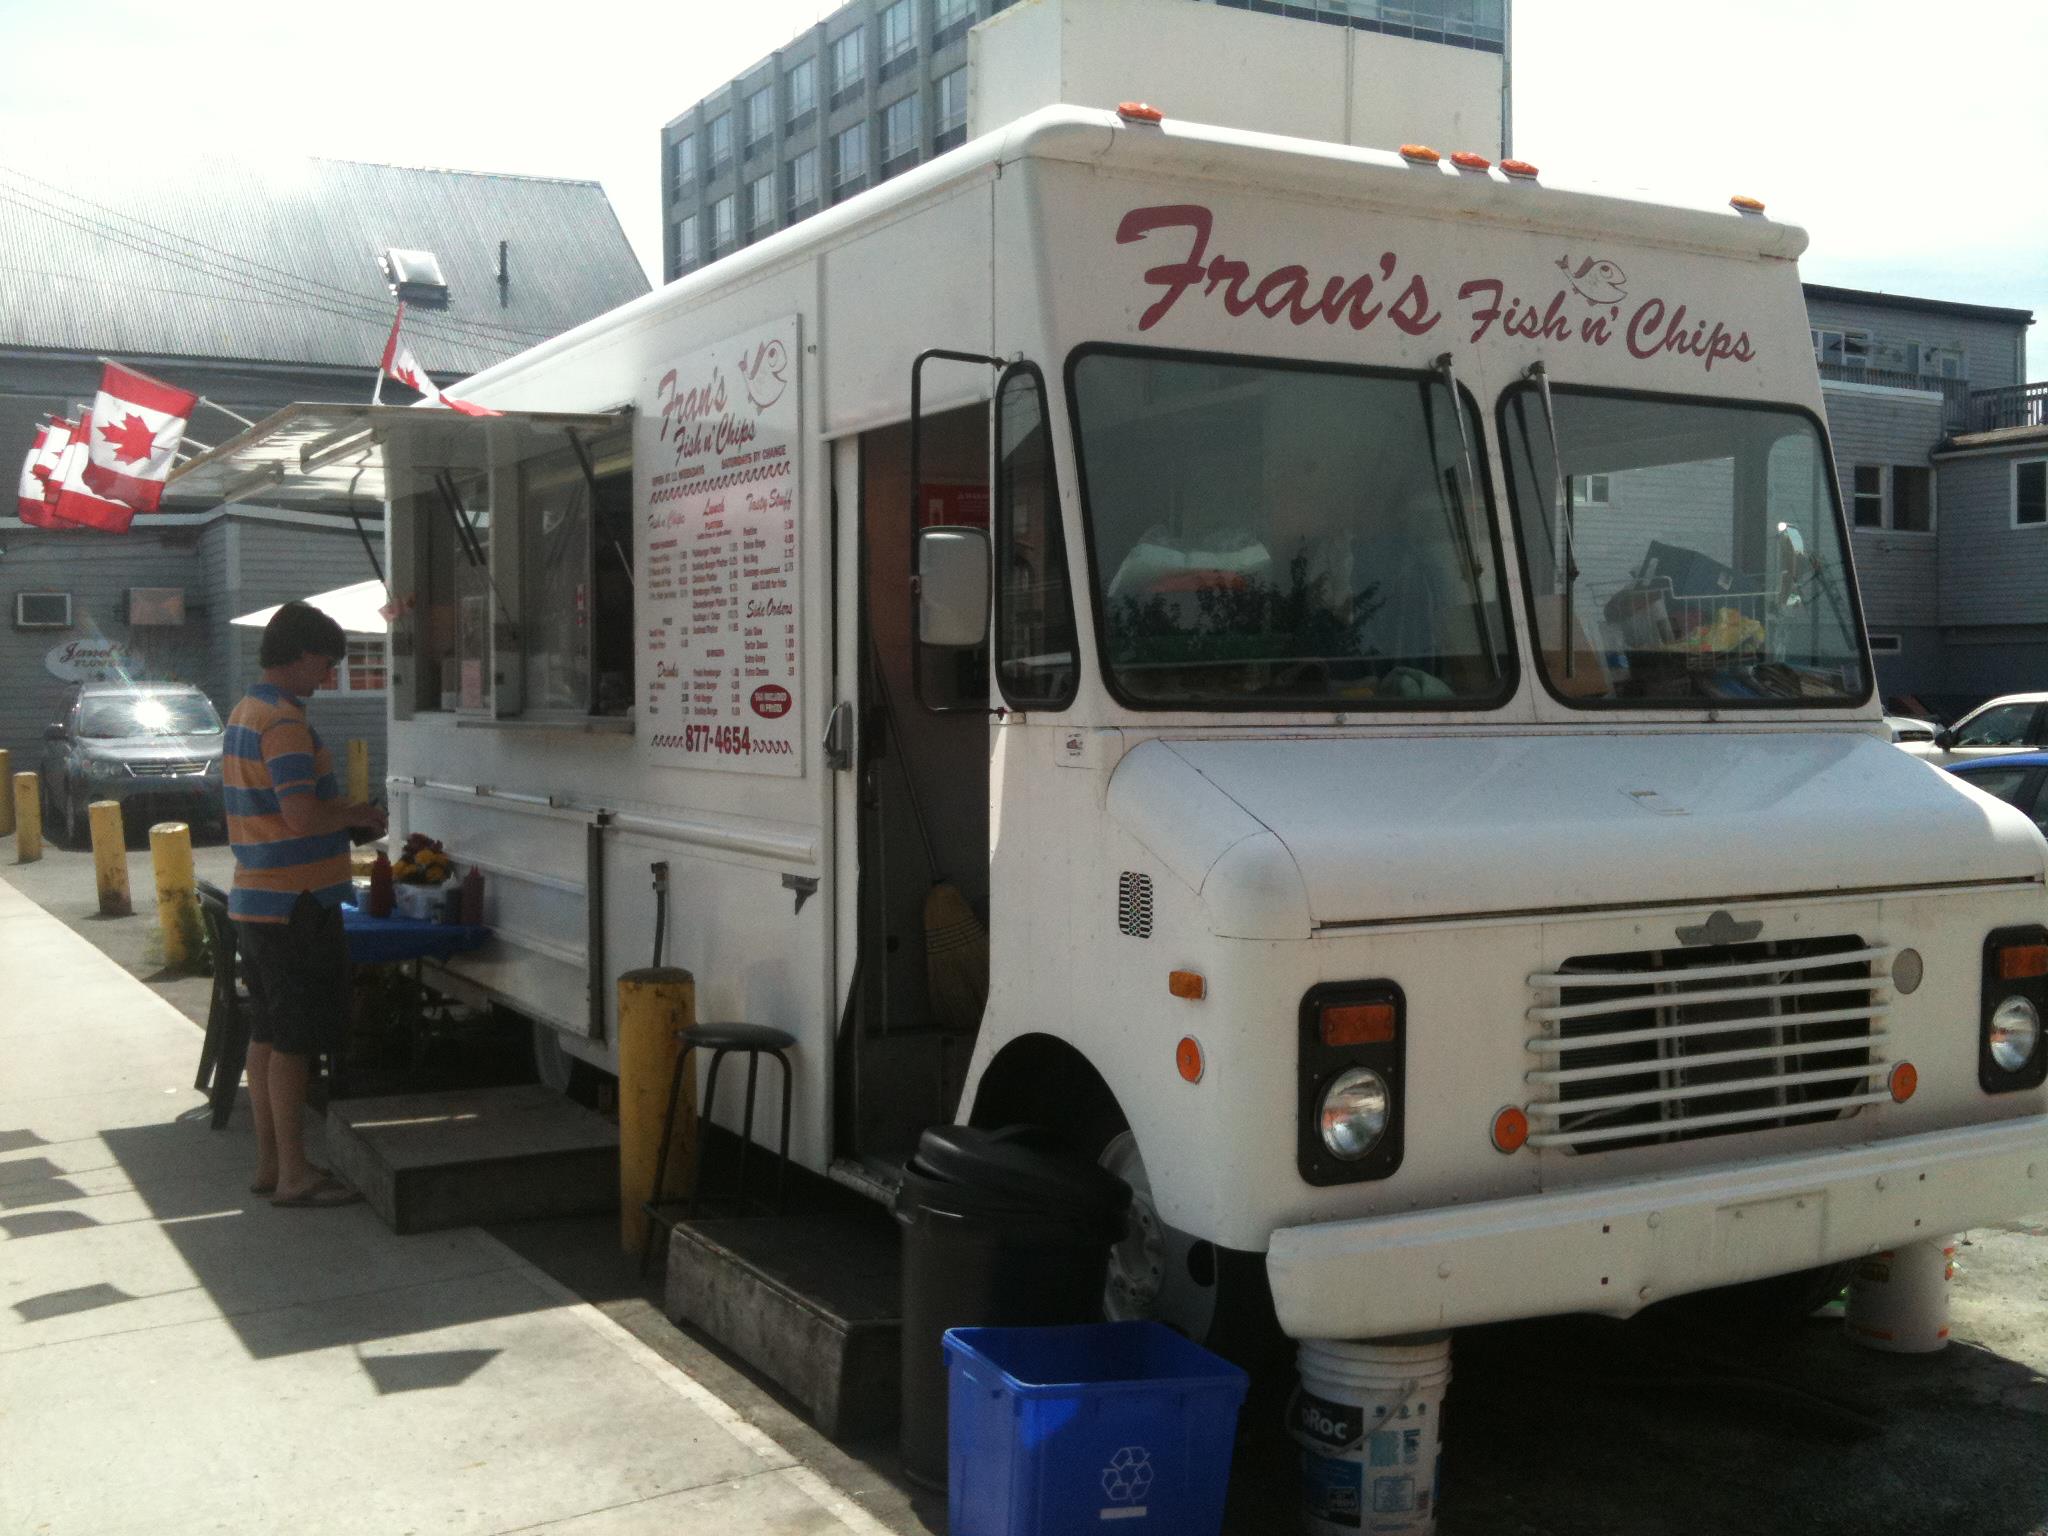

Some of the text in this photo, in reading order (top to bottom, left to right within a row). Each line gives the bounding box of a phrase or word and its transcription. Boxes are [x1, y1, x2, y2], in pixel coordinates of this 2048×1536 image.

[1116, 205, 1441, 335] Fran's
[1458, 279, 1572, 343] Fish
[1627, 298, 1756, 372] Chips
[658, 366, 727, 441] Fran's
[674, 424, 702, 467] Fish
[715, 412, 756, 455] Chips
[769, 488, 792, 512] Stuff
[746, 600, 766, 618] Side
[767, 598, 793, 616] Orders
[685, 724, 751, 756] 877-4654
